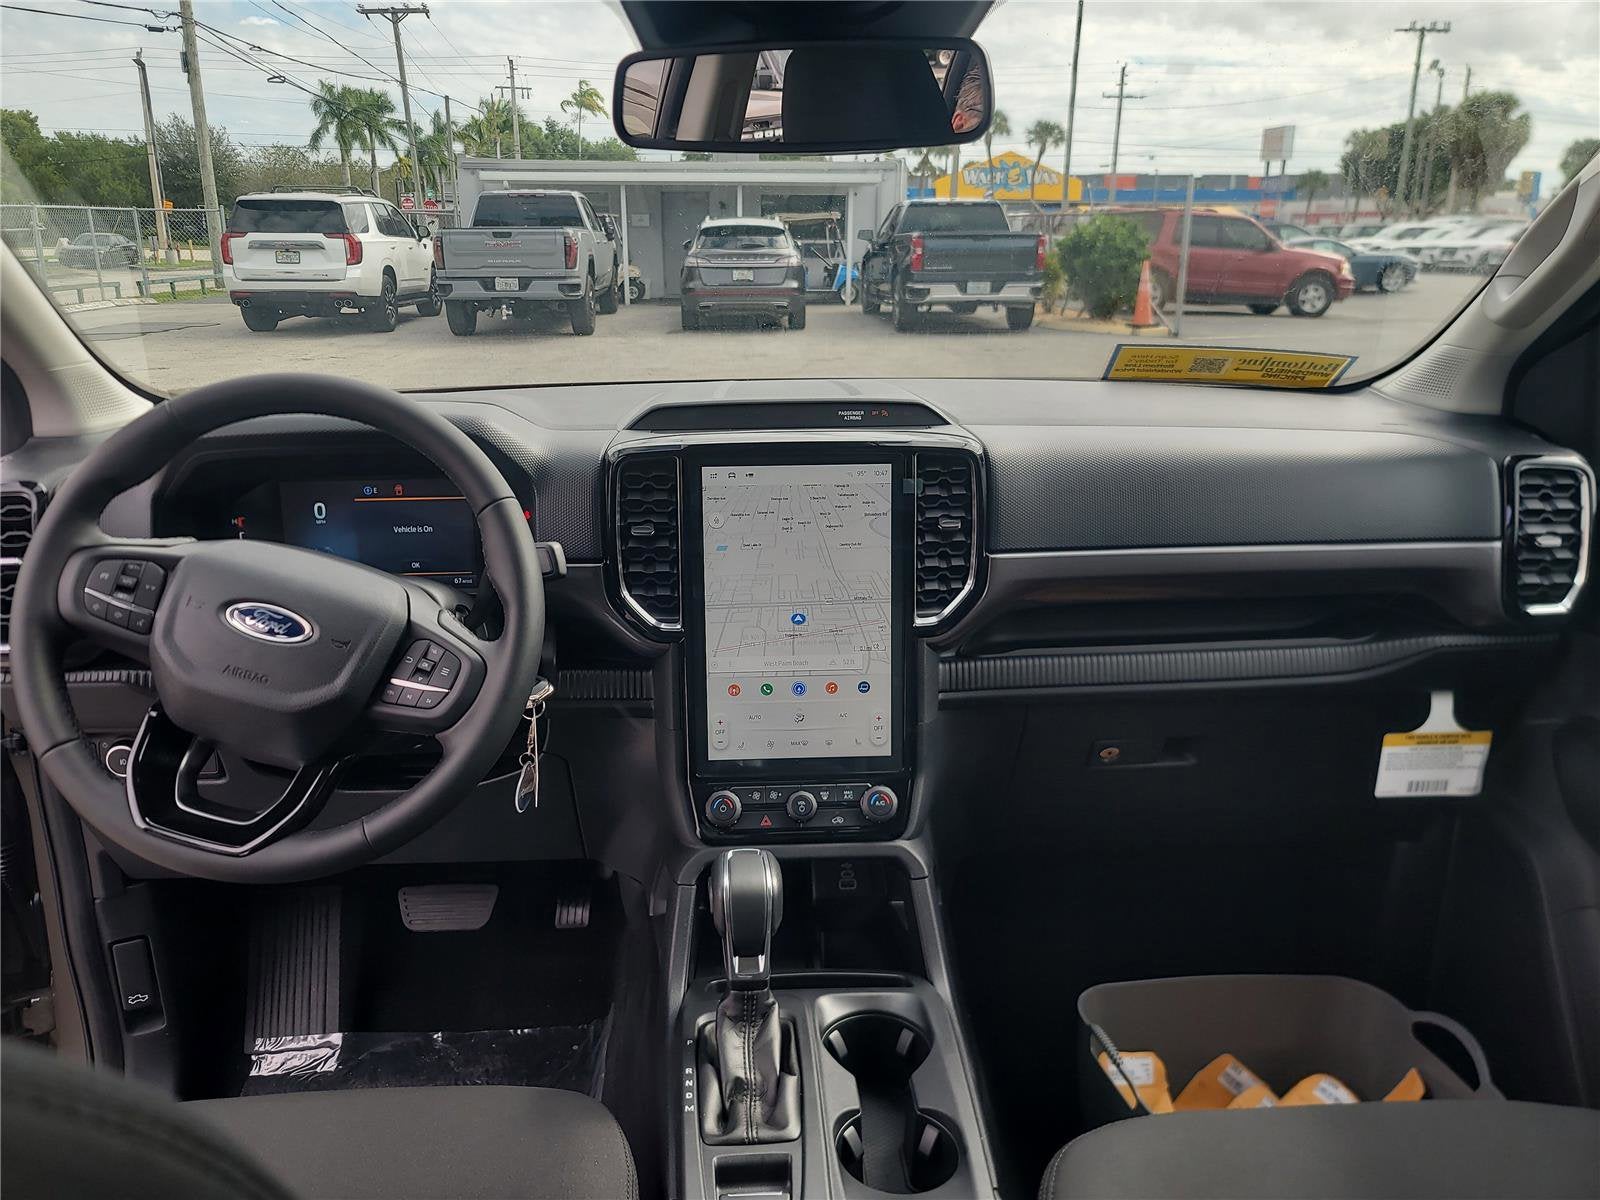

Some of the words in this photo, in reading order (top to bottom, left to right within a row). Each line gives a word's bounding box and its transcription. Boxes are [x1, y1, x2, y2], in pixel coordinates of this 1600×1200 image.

[313, 502, 326, 519] 0
[423, 525, 433, 533] On
[244, 608, 292, 635] Ford
[222, 664, 270, 684] AIRBAG
[685, 1079, 693, 1087] N
